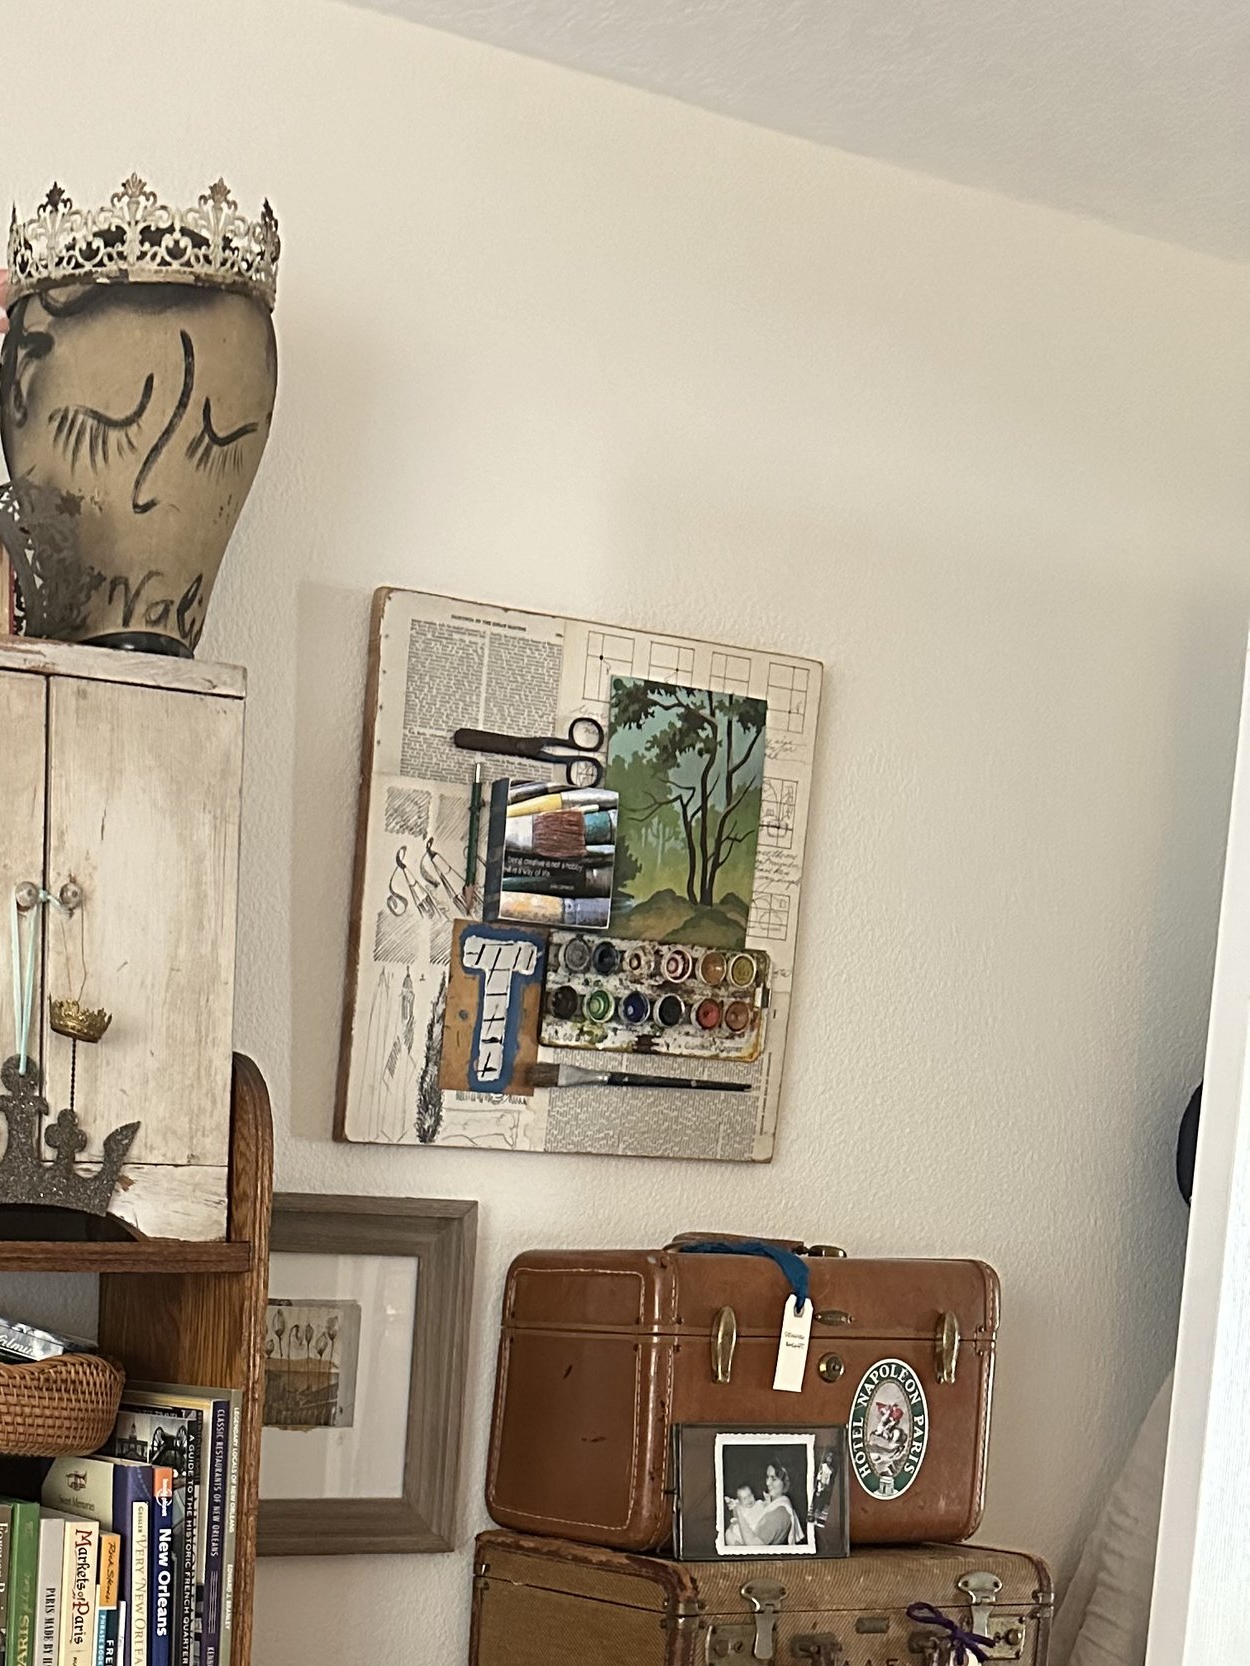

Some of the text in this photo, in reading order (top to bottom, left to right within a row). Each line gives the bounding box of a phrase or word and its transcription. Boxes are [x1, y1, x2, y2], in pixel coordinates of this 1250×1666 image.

[853, 1417, 871, 1479] HOTEL
[903, 1414, 925, 1474] PARIS
[157, 1529, 172, 1637] New Orleans
